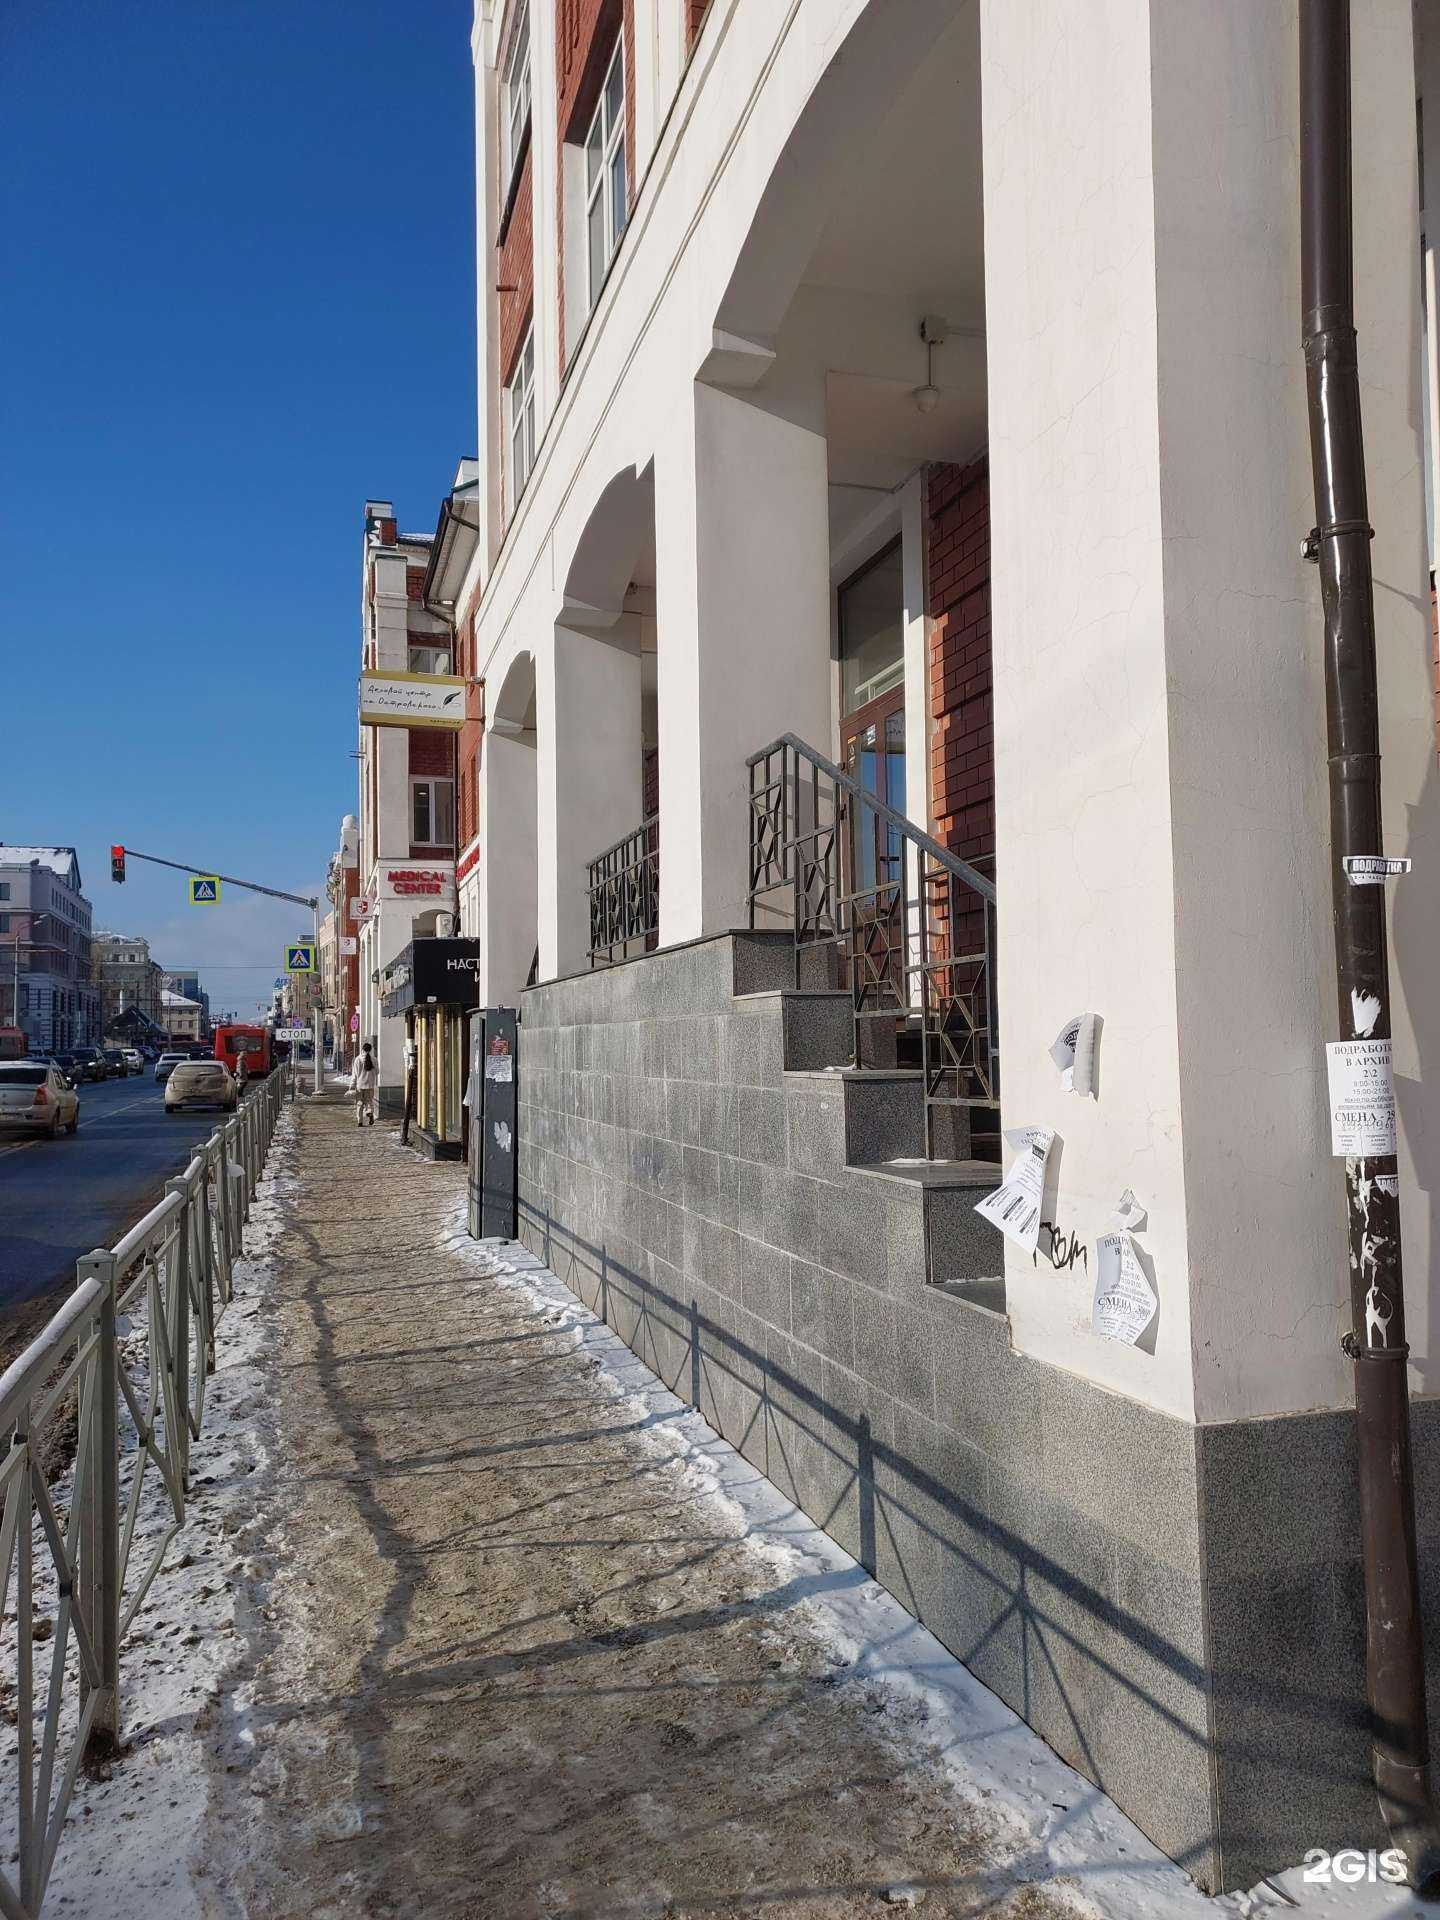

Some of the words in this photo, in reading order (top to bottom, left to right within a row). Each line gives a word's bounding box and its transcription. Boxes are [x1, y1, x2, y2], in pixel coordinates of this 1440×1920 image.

[387, 870, 447, 882] MEDICAL
[393, 883, 442, 895] CENTER
[281, 1030, 307, 1039] СТОП
